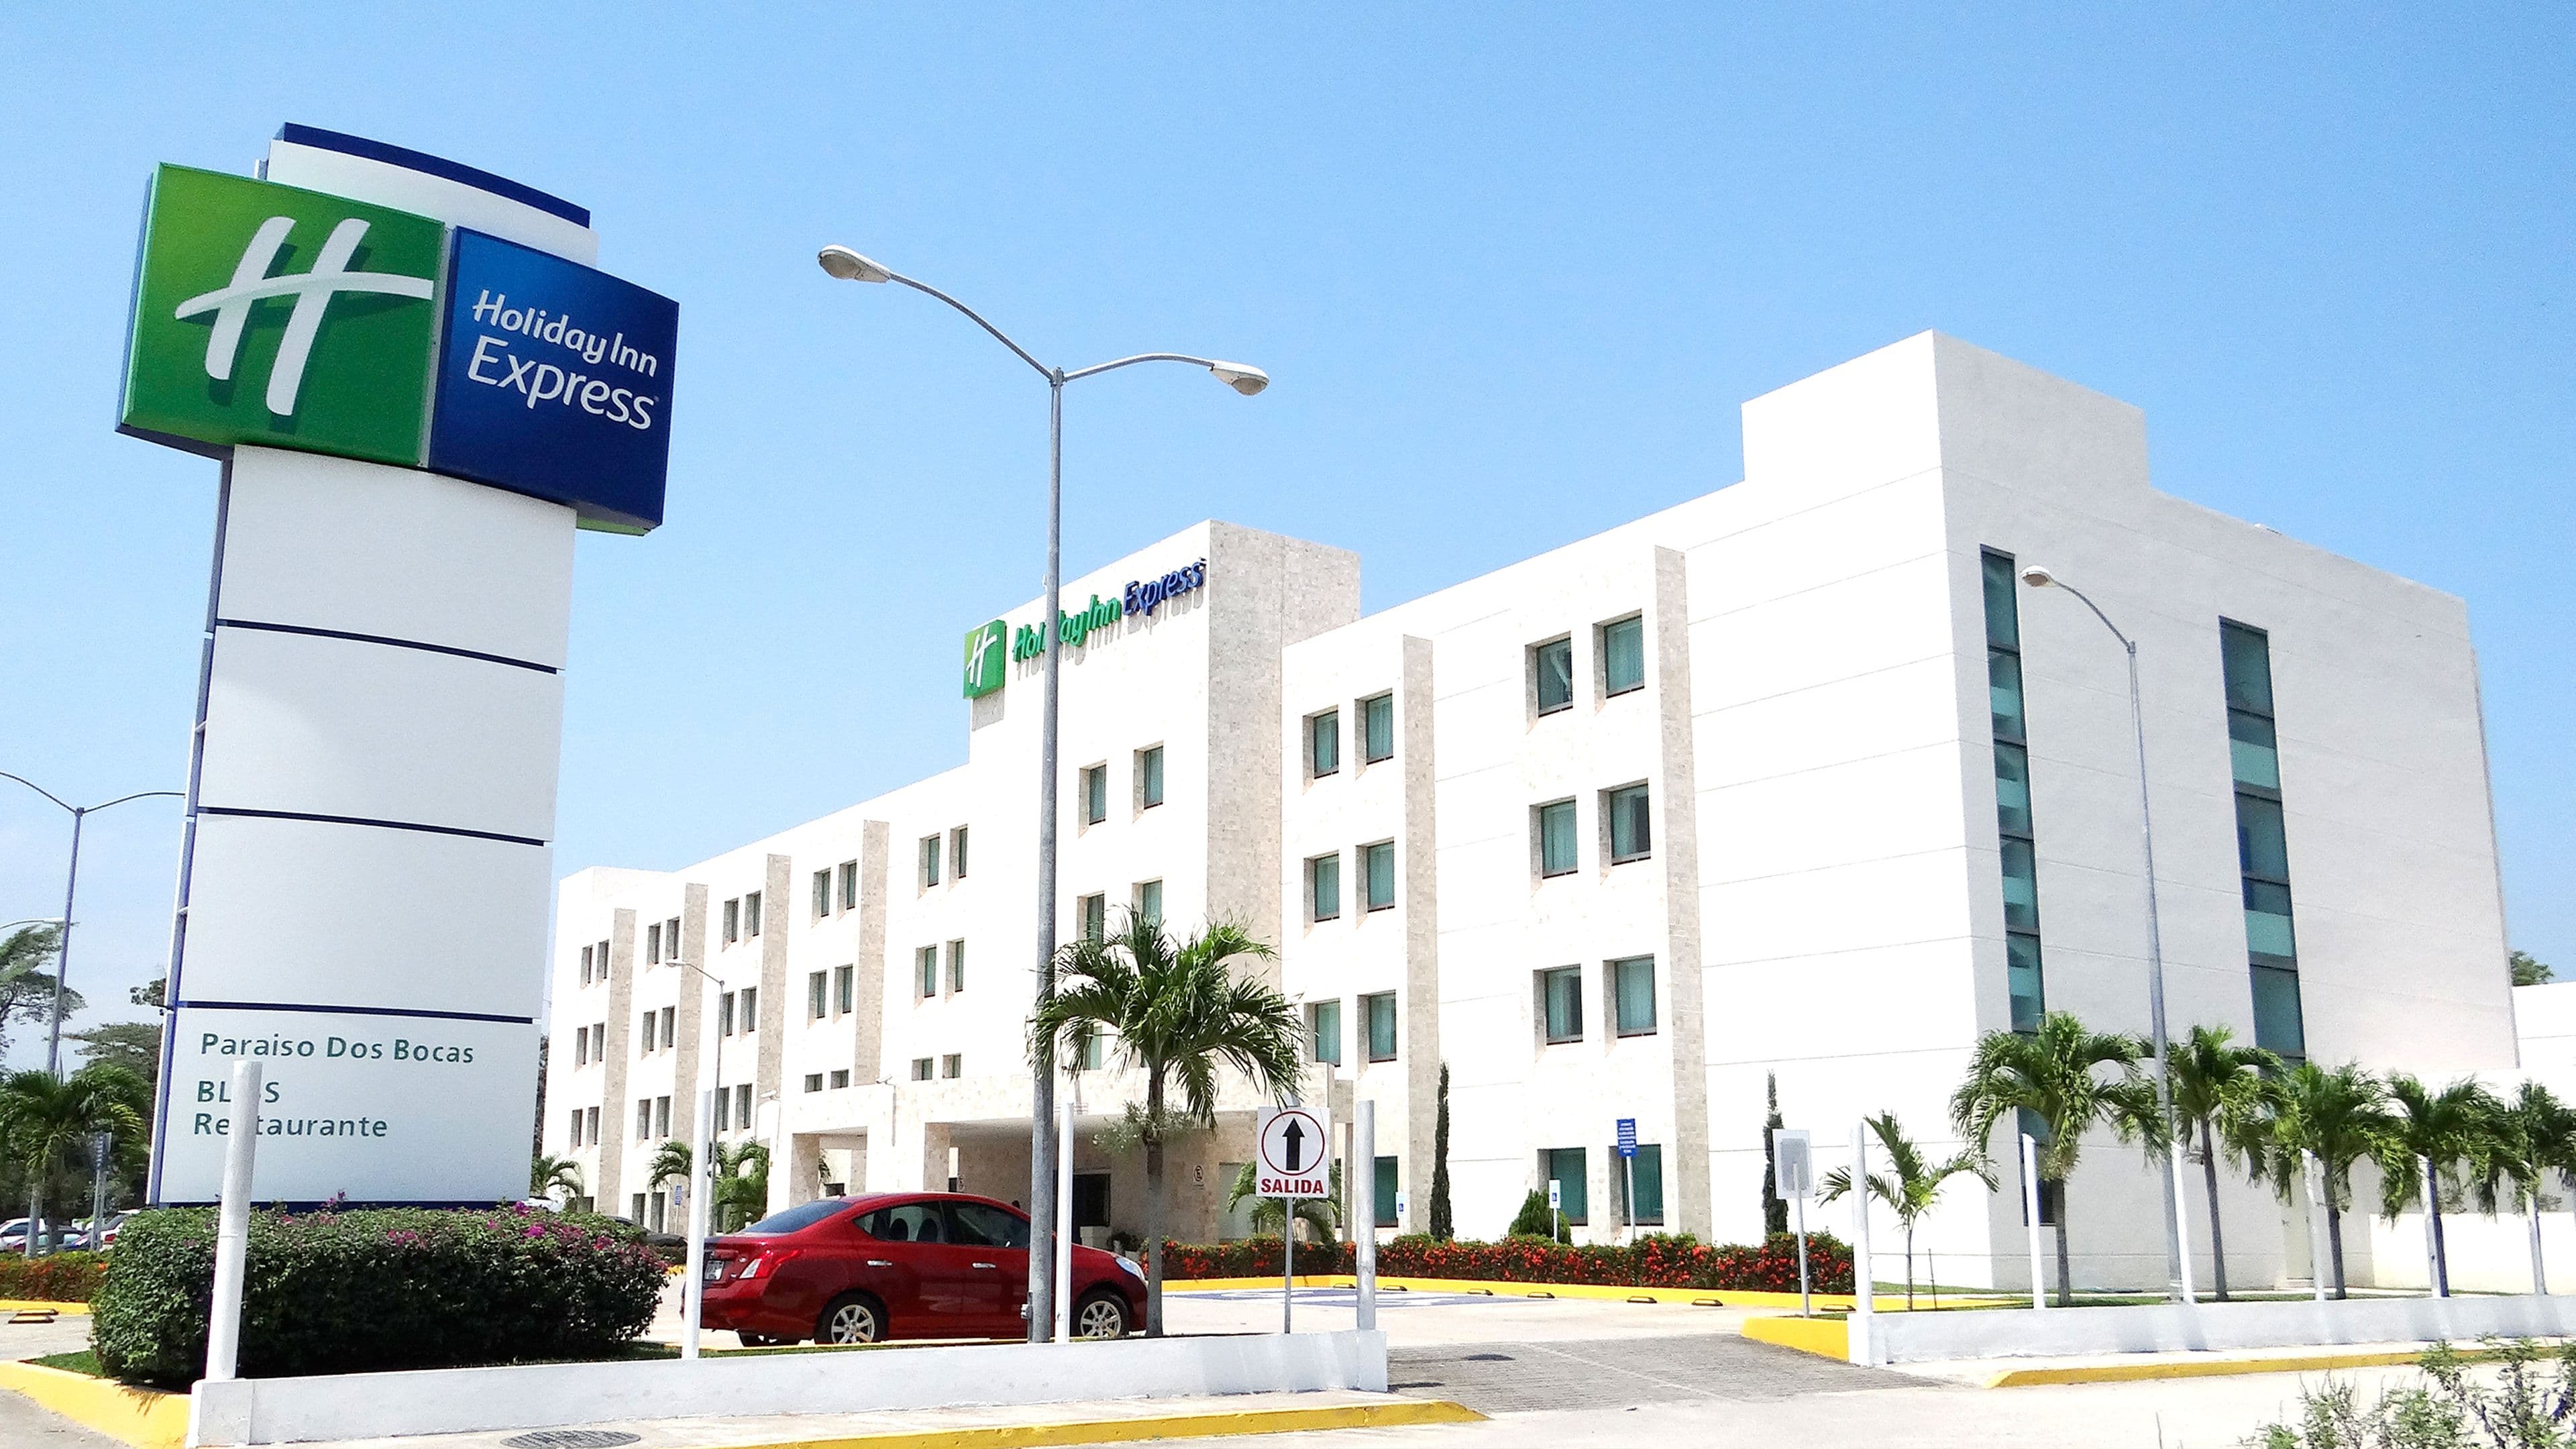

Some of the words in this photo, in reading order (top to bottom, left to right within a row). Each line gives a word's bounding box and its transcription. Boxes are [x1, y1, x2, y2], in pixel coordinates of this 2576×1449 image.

[472, 289, 607, 364] Holiday
[610, 332, 657, 378] Inn
[467, 334, 655, 430] Express
[1012, 610, 1089, 663] Holay
[1086, 594, 1122, 632] Inn
[1123, 561, 1206, 616] Express
[201, 1032, 315, 1058] Paraiso
[326, 1036, 383, 1059] Dos
[393, 1038, 474, 1064] Bocas
[197, 1080, 280, 1104] BLS
[194, 1112, 388, 1137] Retaurante
[1260, 1178, 1324, 1194] SALIDA
